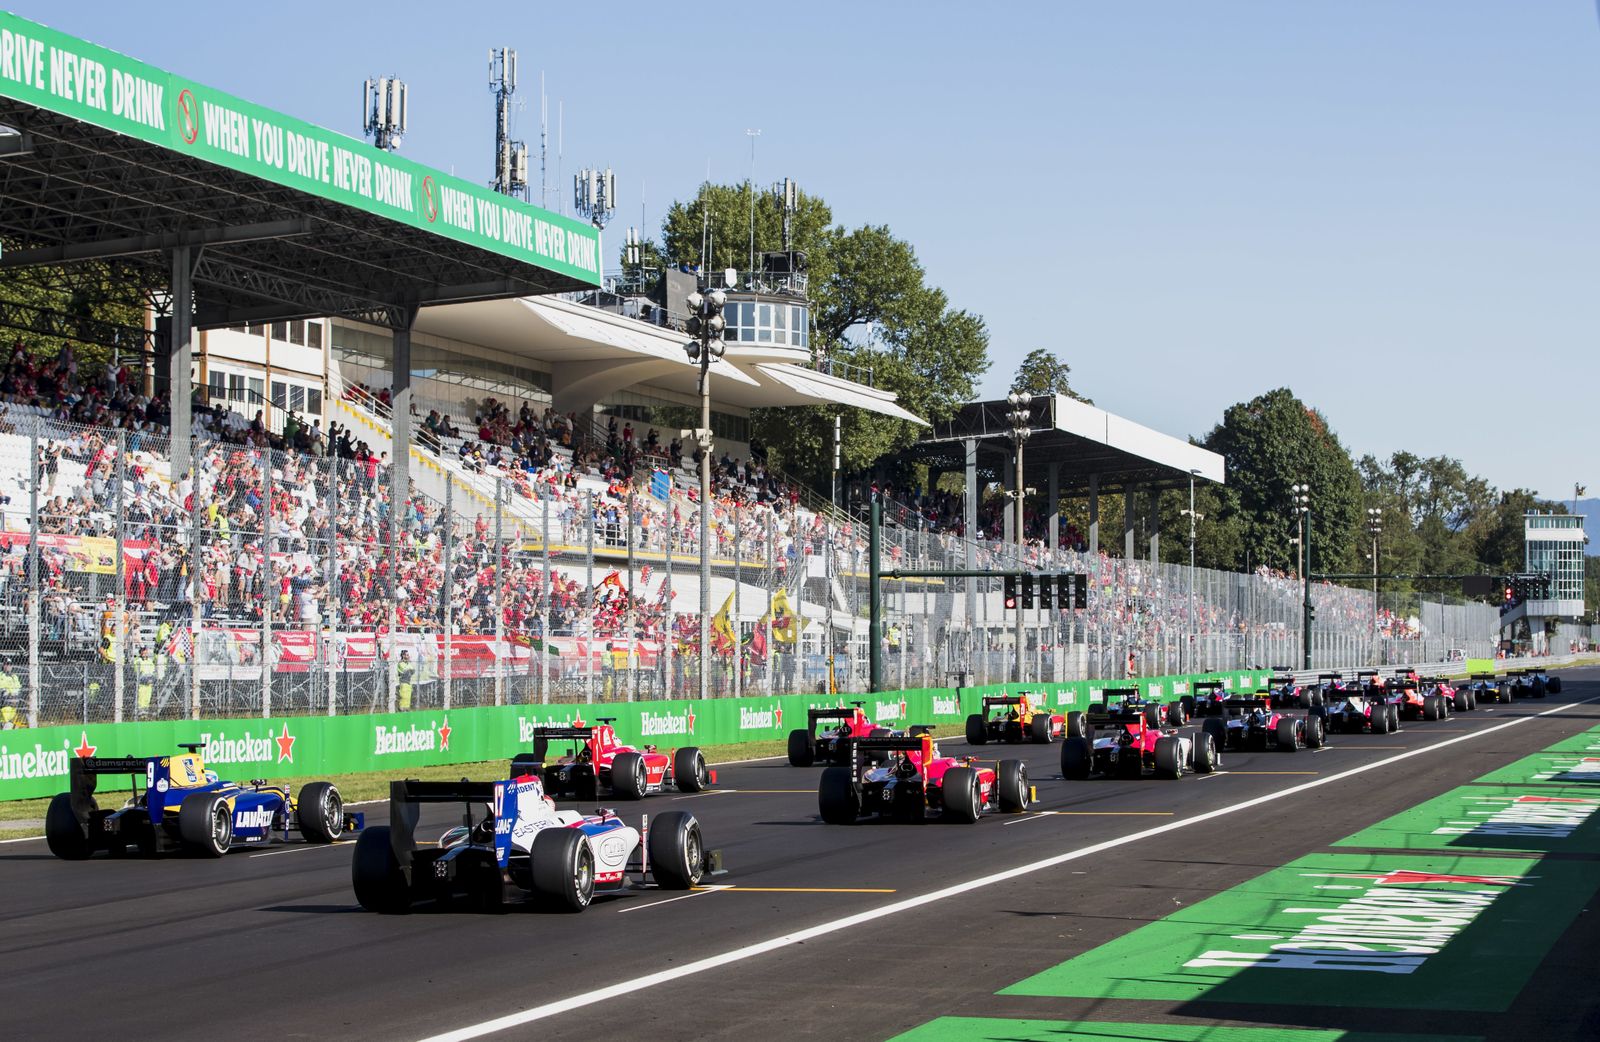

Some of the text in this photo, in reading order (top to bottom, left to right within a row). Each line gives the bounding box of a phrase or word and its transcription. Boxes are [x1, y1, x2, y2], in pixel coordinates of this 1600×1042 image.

[0, 29, 165, 131] RIVE NEVER DRINK
[203, 101, 414, 212] WHEN YOU DRIVE NEVER DRINK
[440, 184, 598, 273] WHEN YOU DRIVE NEVER DRINK
[641, 710, 687, 736] Heineken
[740, 706, 773, 729] Heineken
[200, 731, 273, 764] Heineken
[375, 724, 435, 755] Heineken
[0, 743, 69, 780] ineken
[147, 761, 155, 789] 9
[494, 784, 505, 817] 17
[517, 783, 536, 794] IDENT
